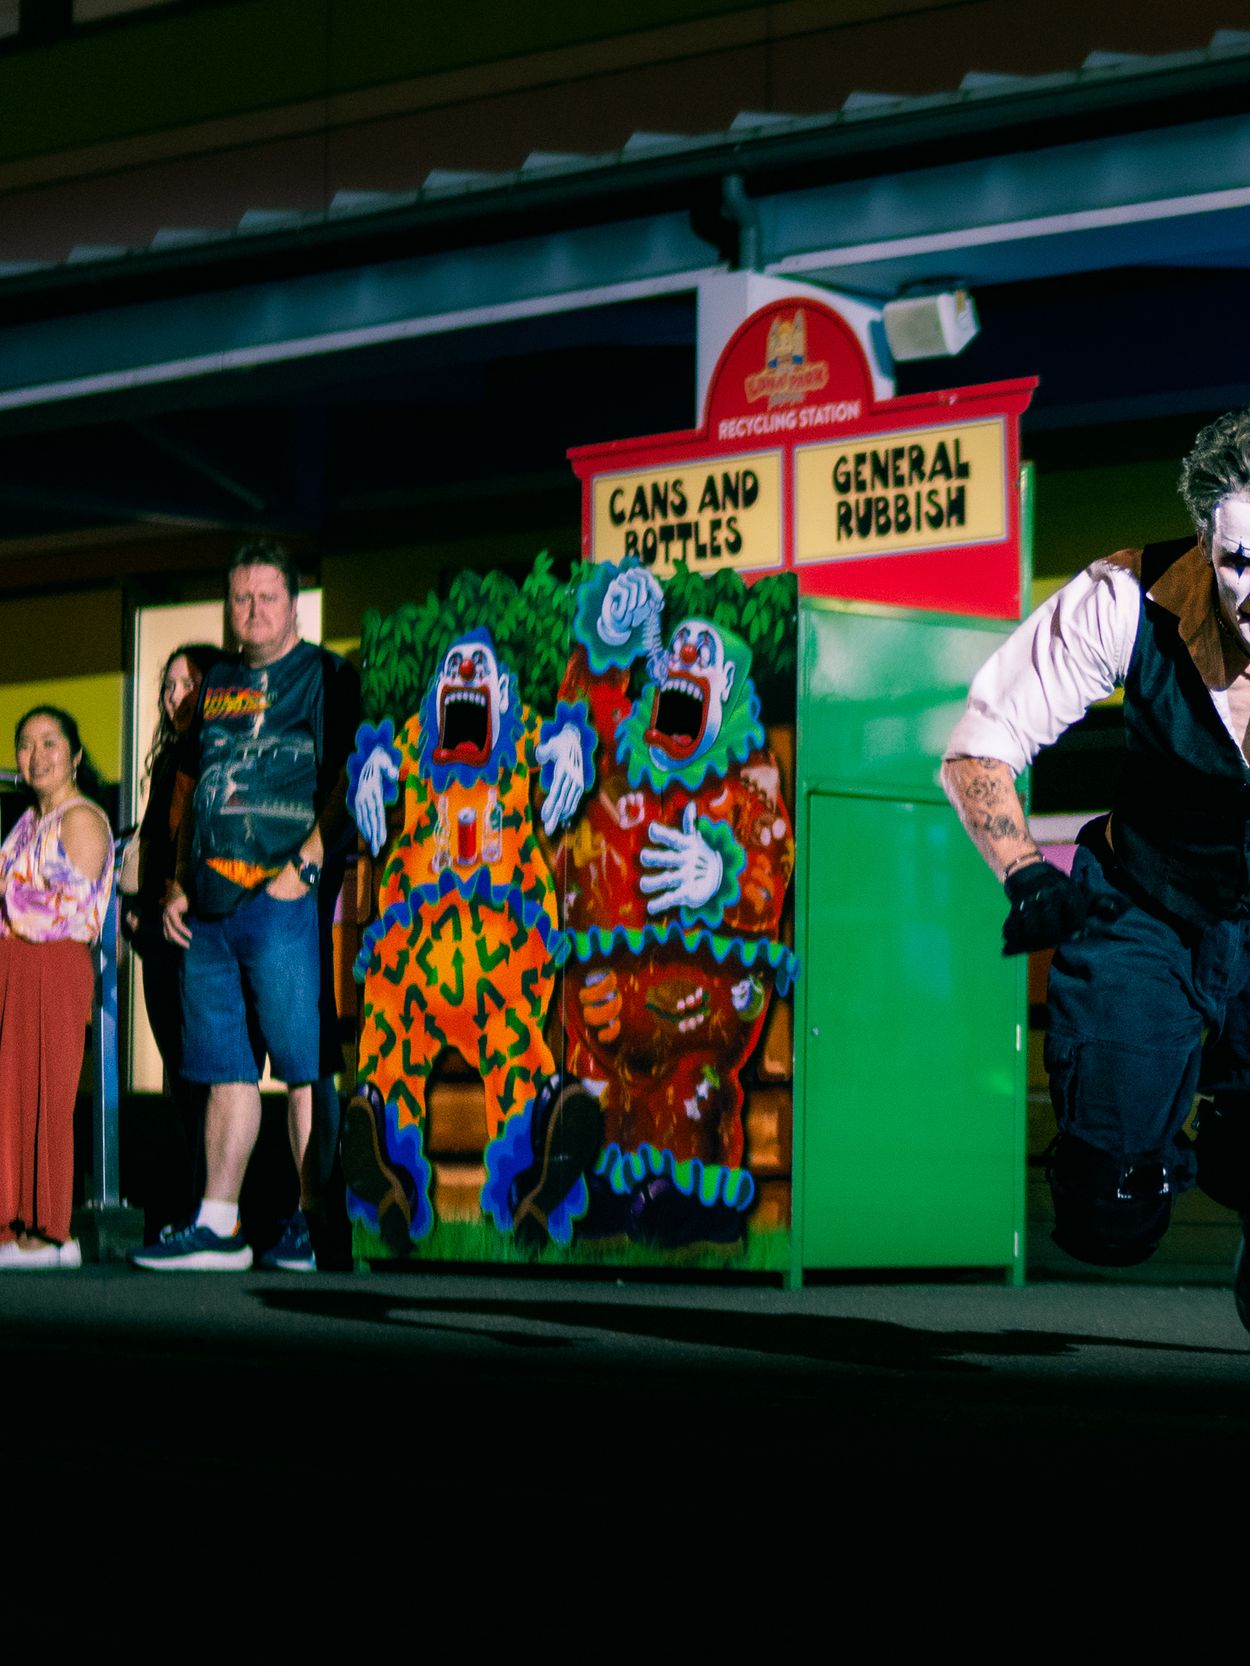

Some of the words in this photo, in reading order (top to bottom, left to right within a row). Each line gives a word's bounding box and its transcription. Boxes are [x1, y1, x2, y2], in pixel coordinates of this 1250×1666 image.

[718, 411, 797, 441] RECYCLING
[800, 400, 861, 427] STATION
[832, 438, 970, 494] GENERAL
[609, 479, 687, 526] CANS
[698, 469, 758, 513] AND
[836, 485, 966, 541] RUBBISH
[625, 516, 742, 566] BOTTLES
